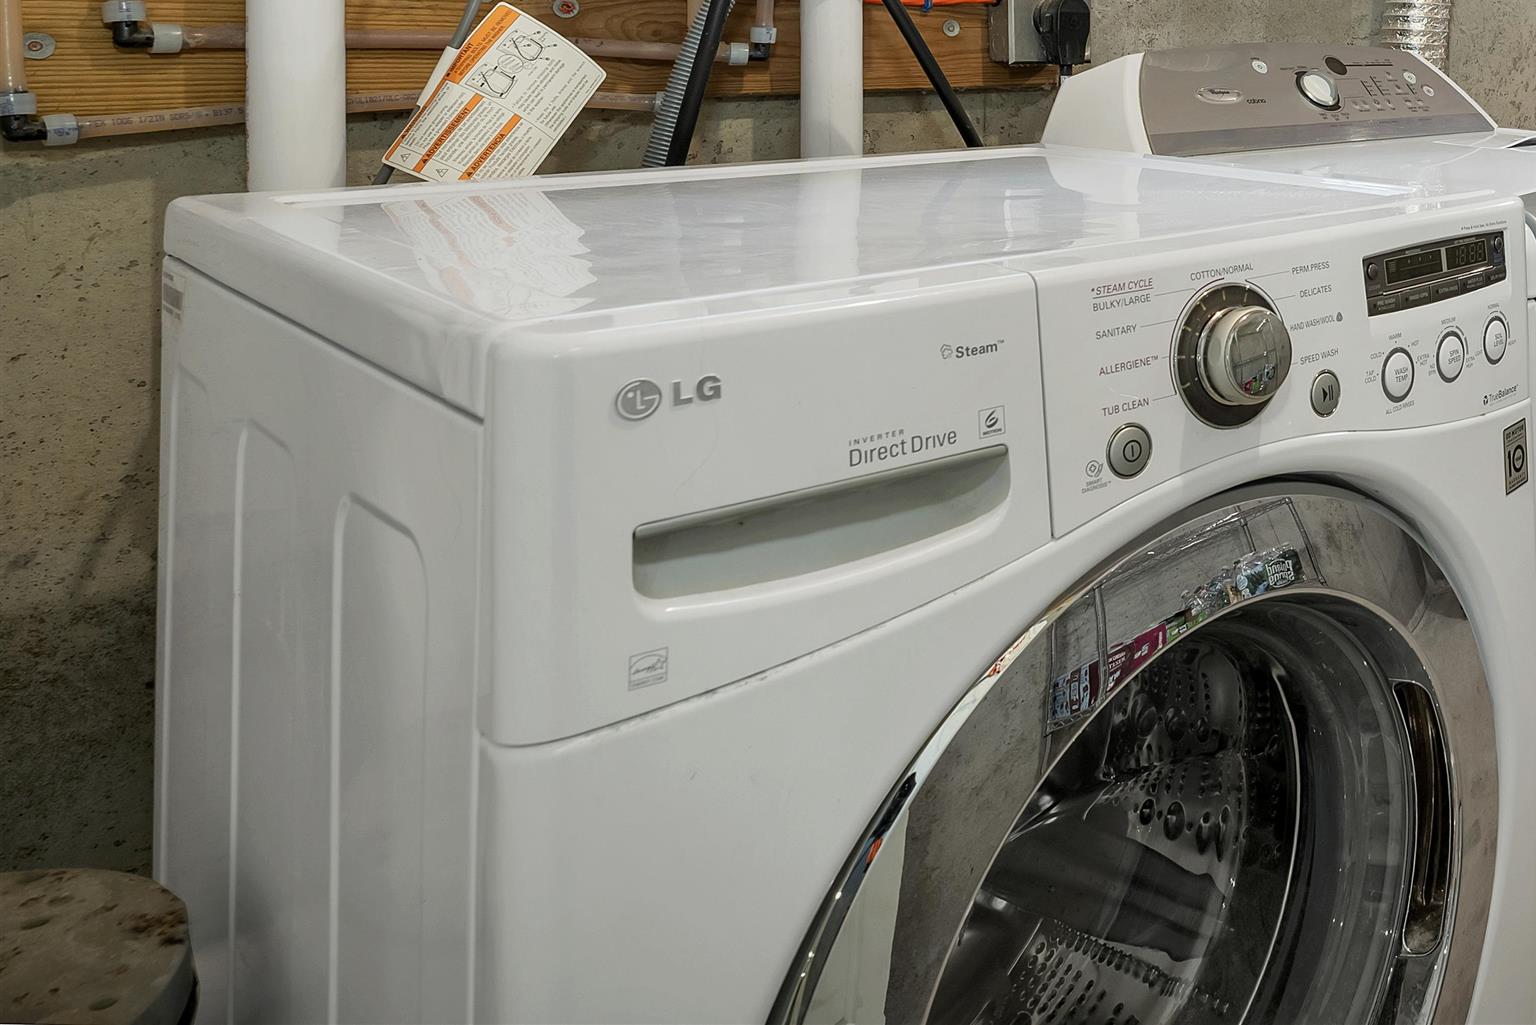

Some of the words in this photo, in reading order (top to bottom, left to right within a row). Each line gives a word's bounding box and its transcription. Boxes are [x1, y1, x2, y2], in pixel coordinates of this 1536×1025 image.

[425, 106, 470, 159] ADVERTISSEMENT
[470, 131, 505, 171] ADVERTENCIA
[1190, 263, 1254, 282] COTTON/NORMAL
[1127, 277, 1153, 290] CYCLE
[1299, 284, 1332, 298] DELICATES
[1092, 294, 1152, 312] BULKY/LARGE
[1096, 324, 1137, 340] SANITARY
[1299, 353, 1320, 365] SPEED
[1320, 347, 1339, 360] WASH
[1394, 367, 1409, 376] WASH
[1395, 374, 1409, 384] TEMP
[671, 373, 722, 407] LG
[1101, 404, 1120, 417] TUB
[1121, 397, 1150, 412] CLEAN
[848, 429, 905, 447] INVERTER
[849, 439, 907, 467] Direct
[911, 430, 957, 454] Drive
